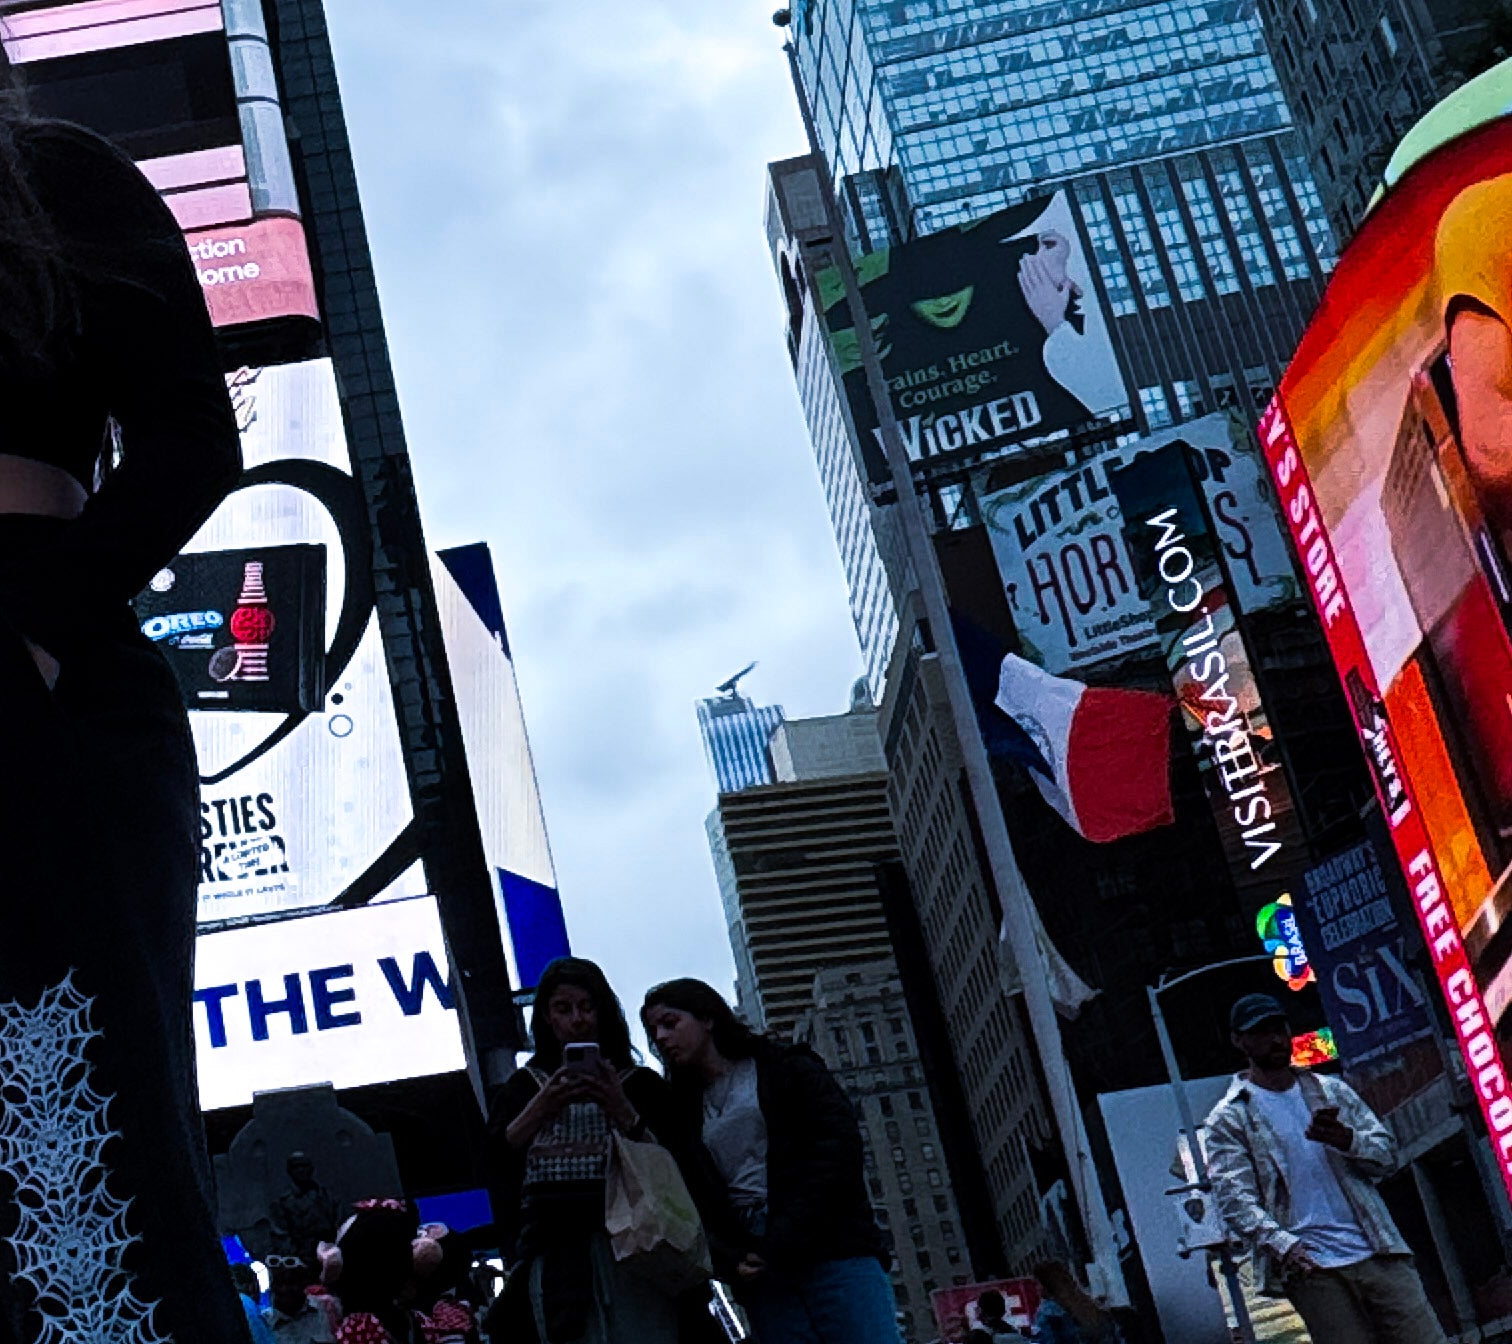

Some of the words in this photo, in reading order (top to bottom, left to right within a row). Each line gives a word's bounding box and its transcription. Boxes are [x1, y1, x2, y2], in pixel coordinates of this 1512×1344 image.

[888, 364, 946, 392] rains.
[947, 339, 1021, 374] Heart.
[899, 369, 999, 409] Courage.
[1290, 484, 1346, 629] STORE
[141, 610, 224, 641] OREO
[1144, 507, 1283, 871] VISITBRASIL.COM
[1407, 847, 1461, 962] FREE
[192, 962, 363, 1049] THE
[1332, 933, 1426, 1034] SIX
